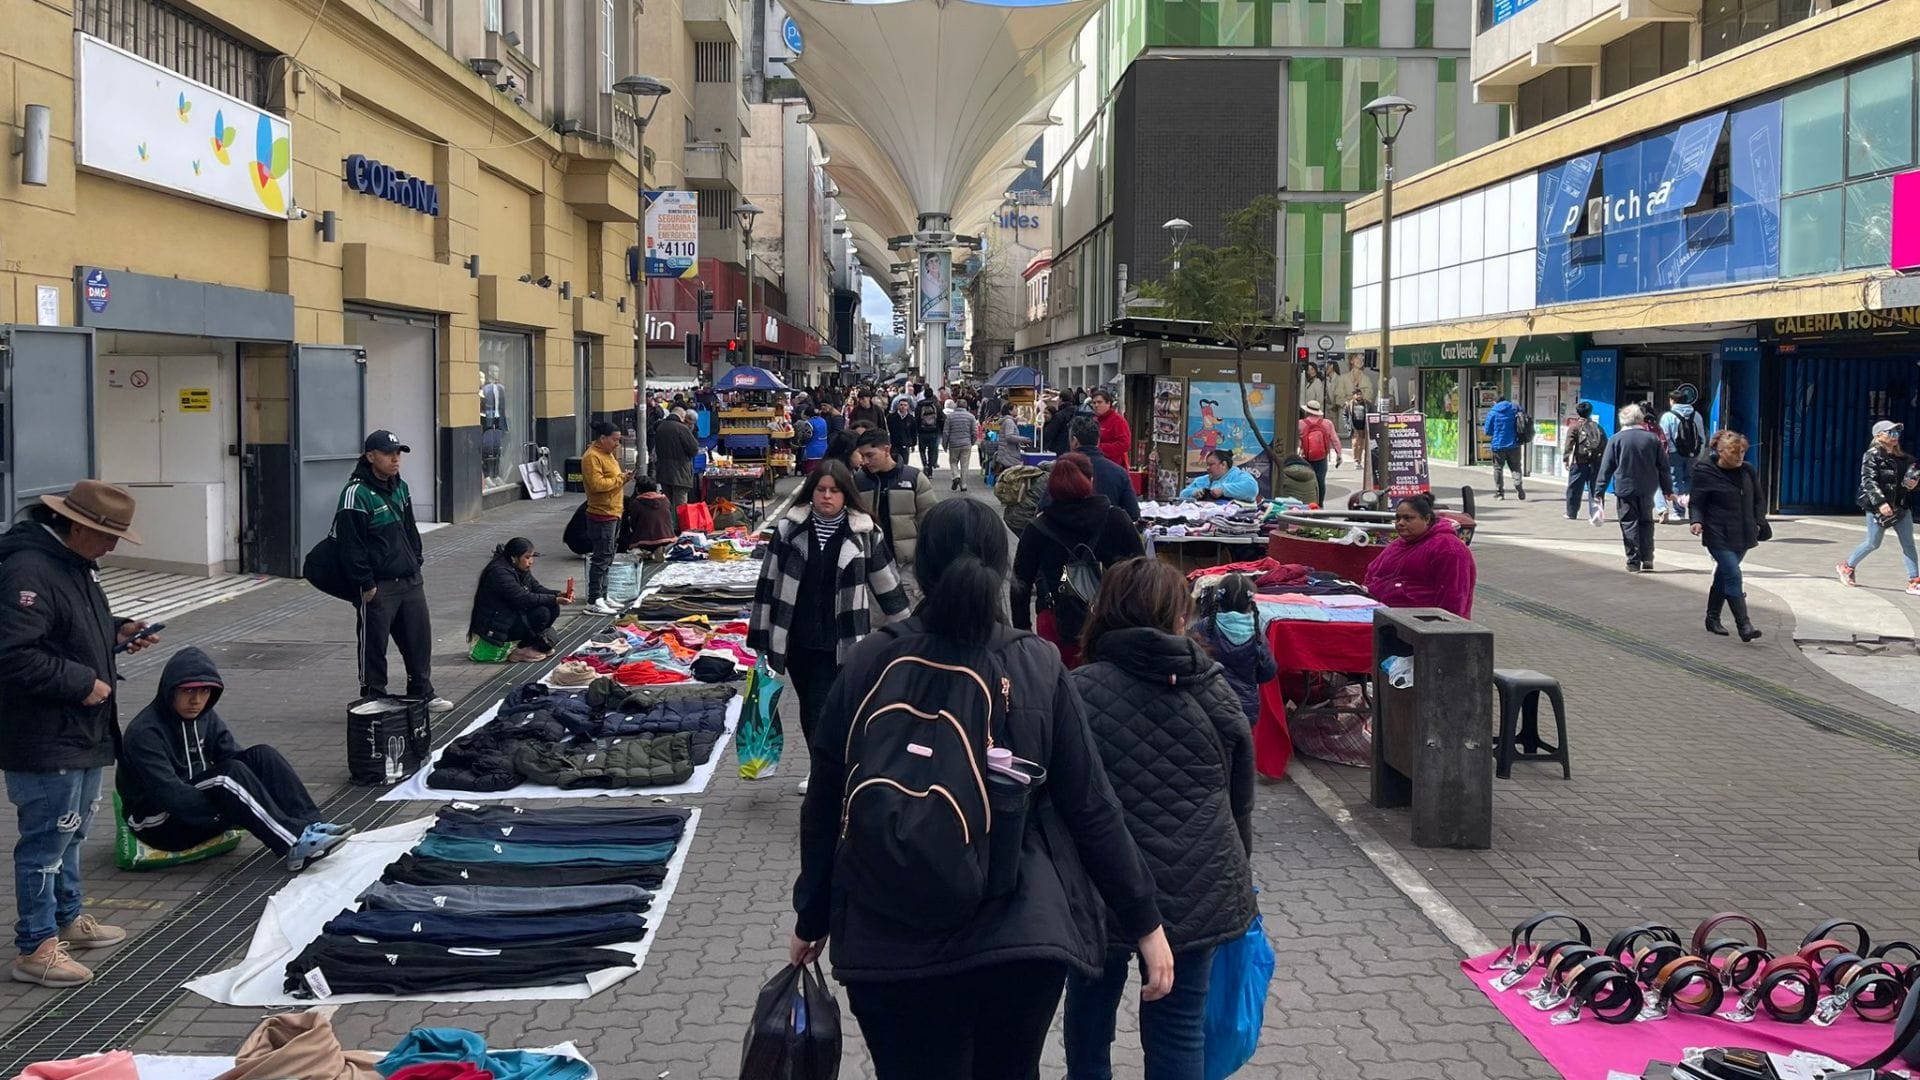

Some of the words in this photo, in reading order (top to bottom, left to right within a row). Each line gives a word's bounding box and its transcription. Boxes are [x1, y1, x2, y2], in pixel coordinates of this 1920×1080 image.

[347, 154, 440, 216] CORONA
[658, 214, 697, 223] SEGURIDAD
[89, 287, 107, 298] DMG
[636, 313, 675, 340] lin
[1774, 312, 1843, 334] GALERIA
[1440, 343, 1456, 360] Cruz
[1456, 341, 1478, 359] Verde
[1725, 345, 1758, 353] pichara
[1586, 356, 1612, 364] pichara
